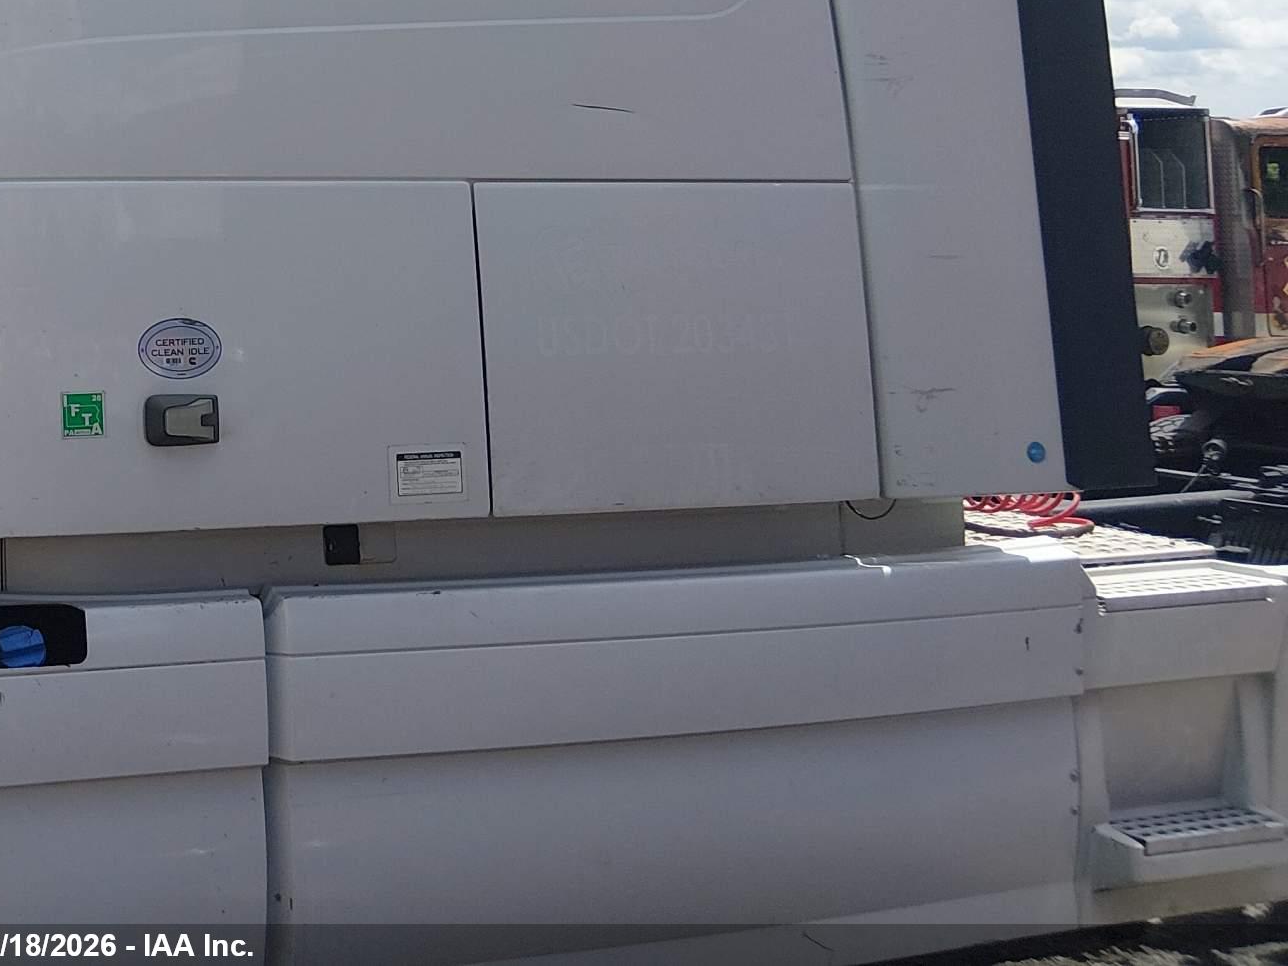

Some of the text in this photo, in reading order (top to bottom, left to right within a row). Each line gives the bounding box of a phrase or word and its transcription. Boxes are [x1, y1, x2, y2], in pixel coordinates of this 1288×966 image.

[155, 337, 205, 347] CERTIFIED
[151, 347, 210, 357] CLEAN IDLE
